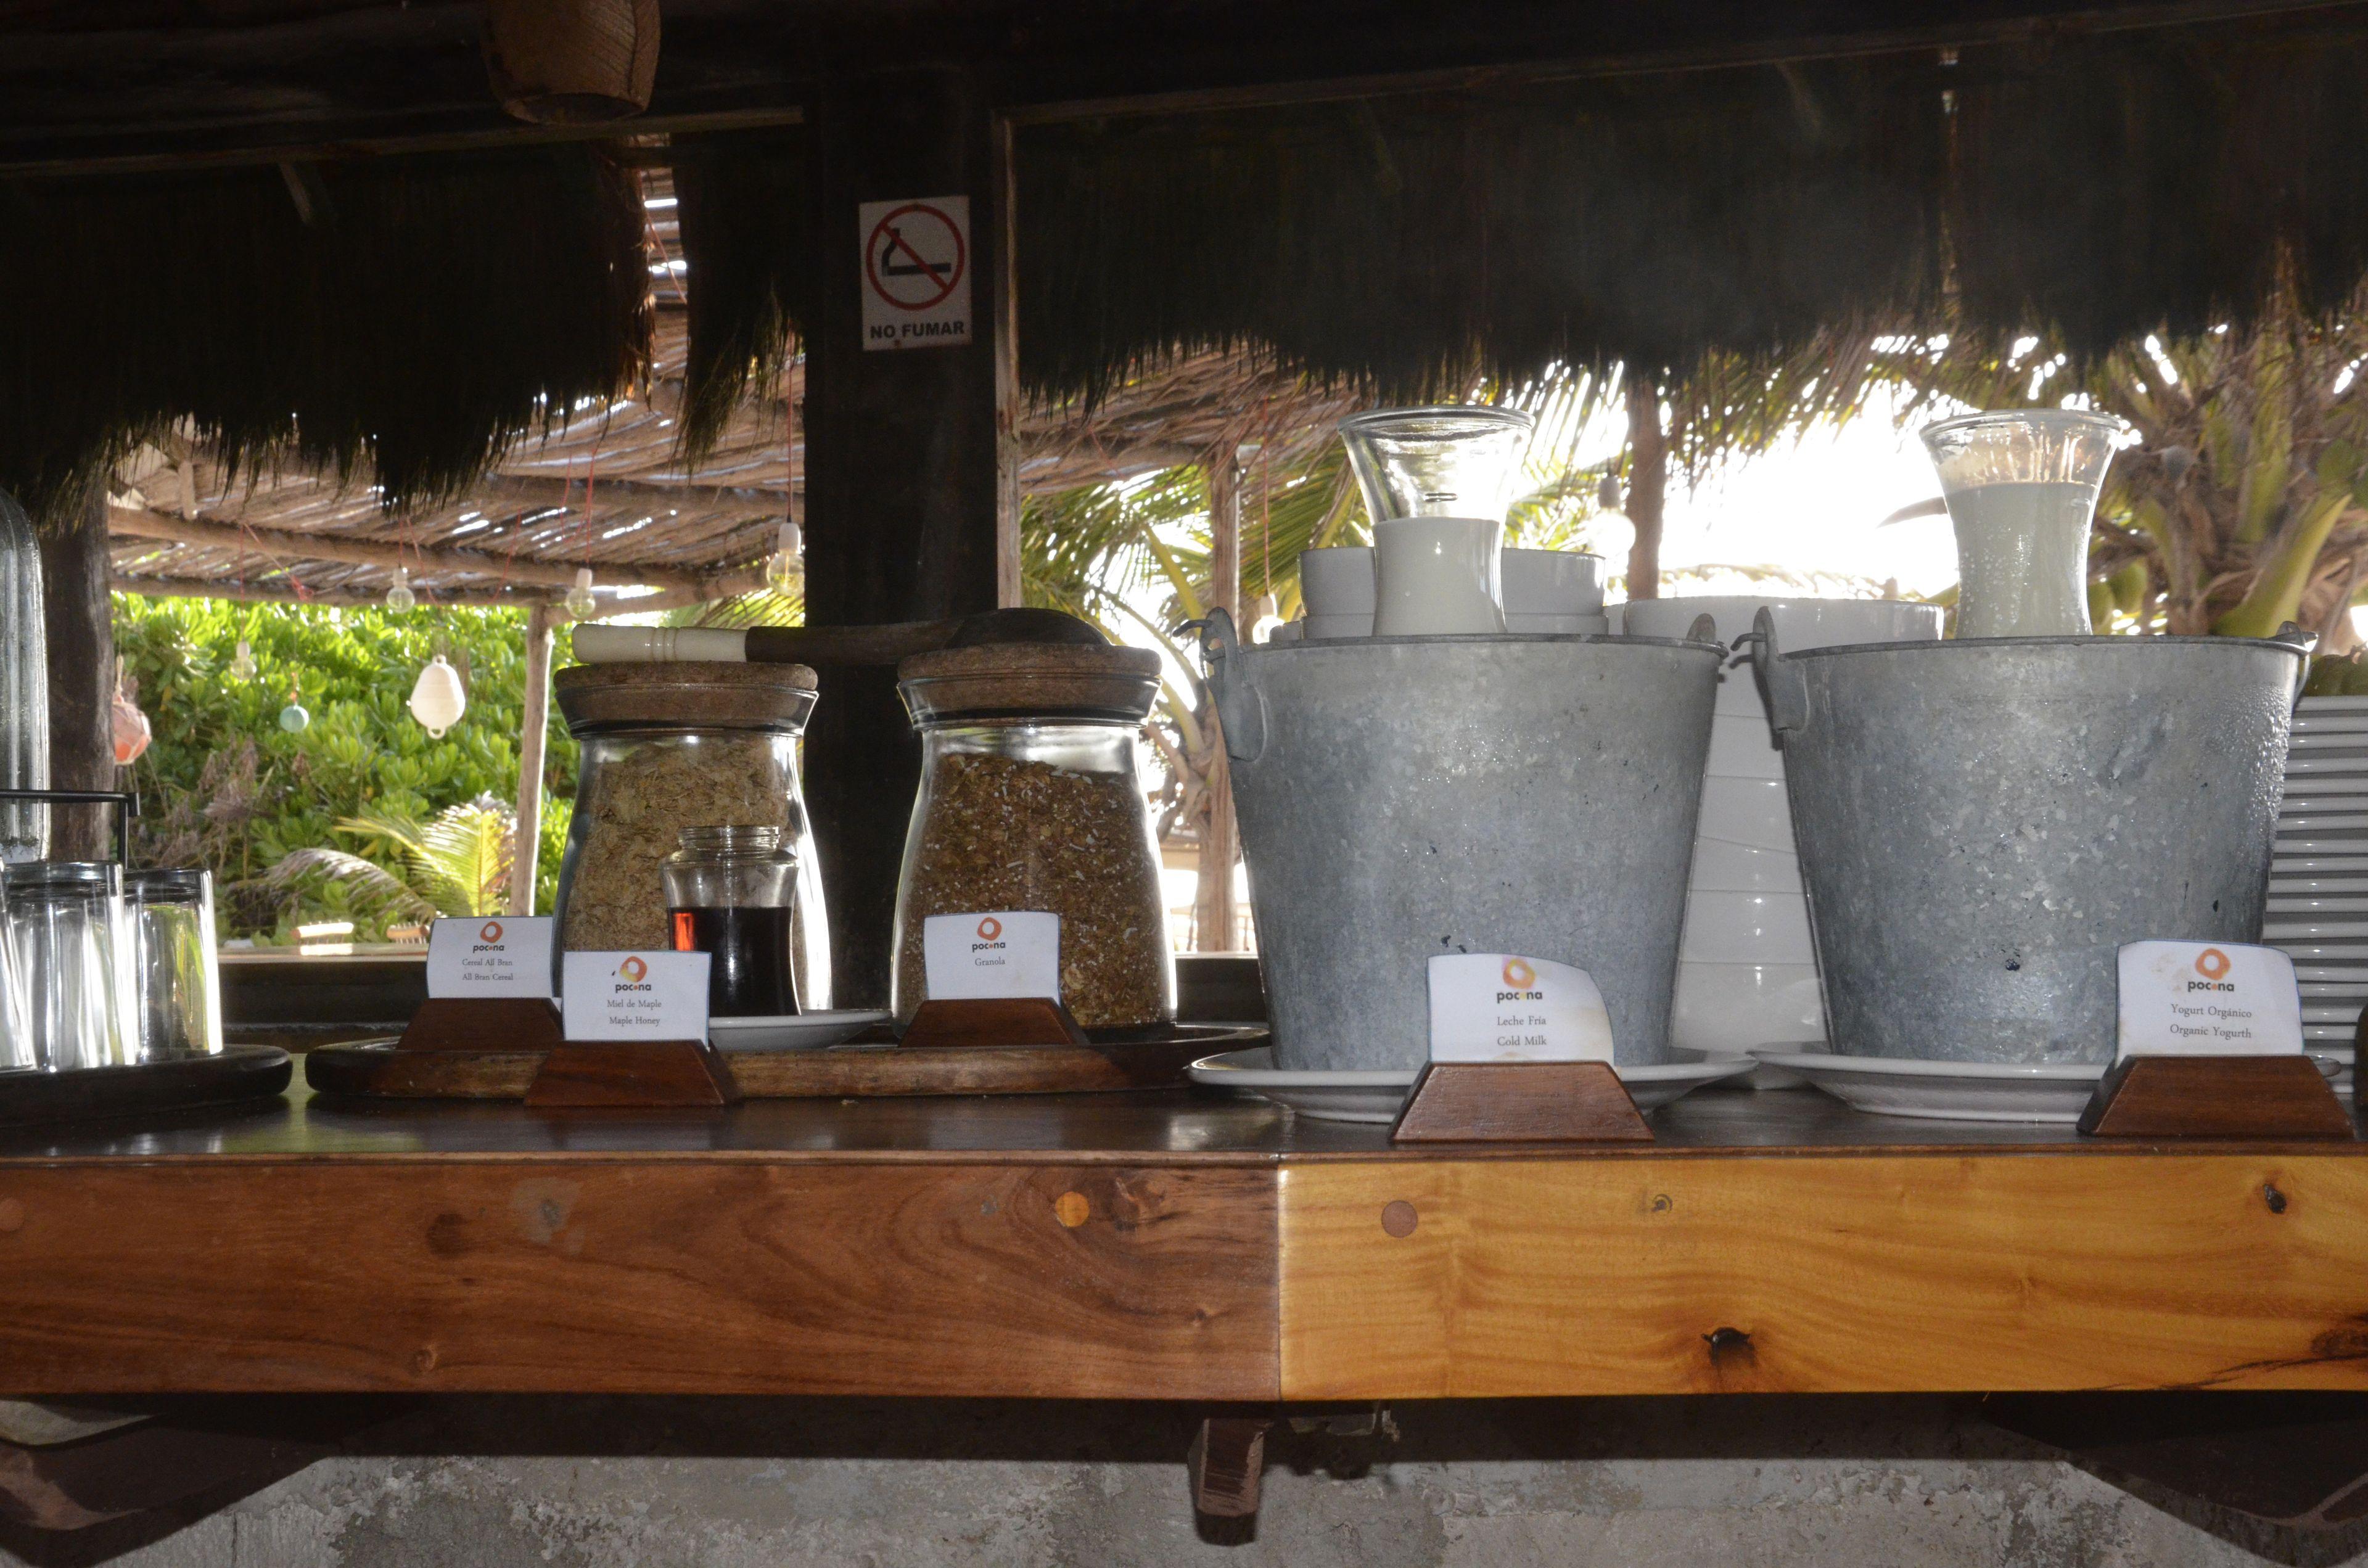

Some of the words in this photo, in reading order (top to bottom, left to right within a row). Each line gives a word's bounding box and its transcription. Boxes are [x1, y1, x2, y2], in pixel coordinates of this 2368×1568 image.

[870, 324, 895, 339] NO
[902, 321, 965, 337] FUMAR
[974, 956, 1005, 966] Granola
[607, 999, 623, 1008] Miel
[627, 999, 635, 1008] de
[638, 999, 662, 1010] Maple
[2171, 1004, 2204, 1017] Yogurt
[2208, 1006, 2252, 1019] Orgánico
[609, 1017, 632, 1026] Maple
[635, 1017, 660, 1027] Honey
[1497, 1016, 1524, 1026] Leche
[2170, 1024, 2208, 1037] Organic
[2213, 1027, 2251, 1040] Yogurth
[1497, 1036, 1520, 1046] Cold
[1524, 1035, 1547, 1045] Milk
